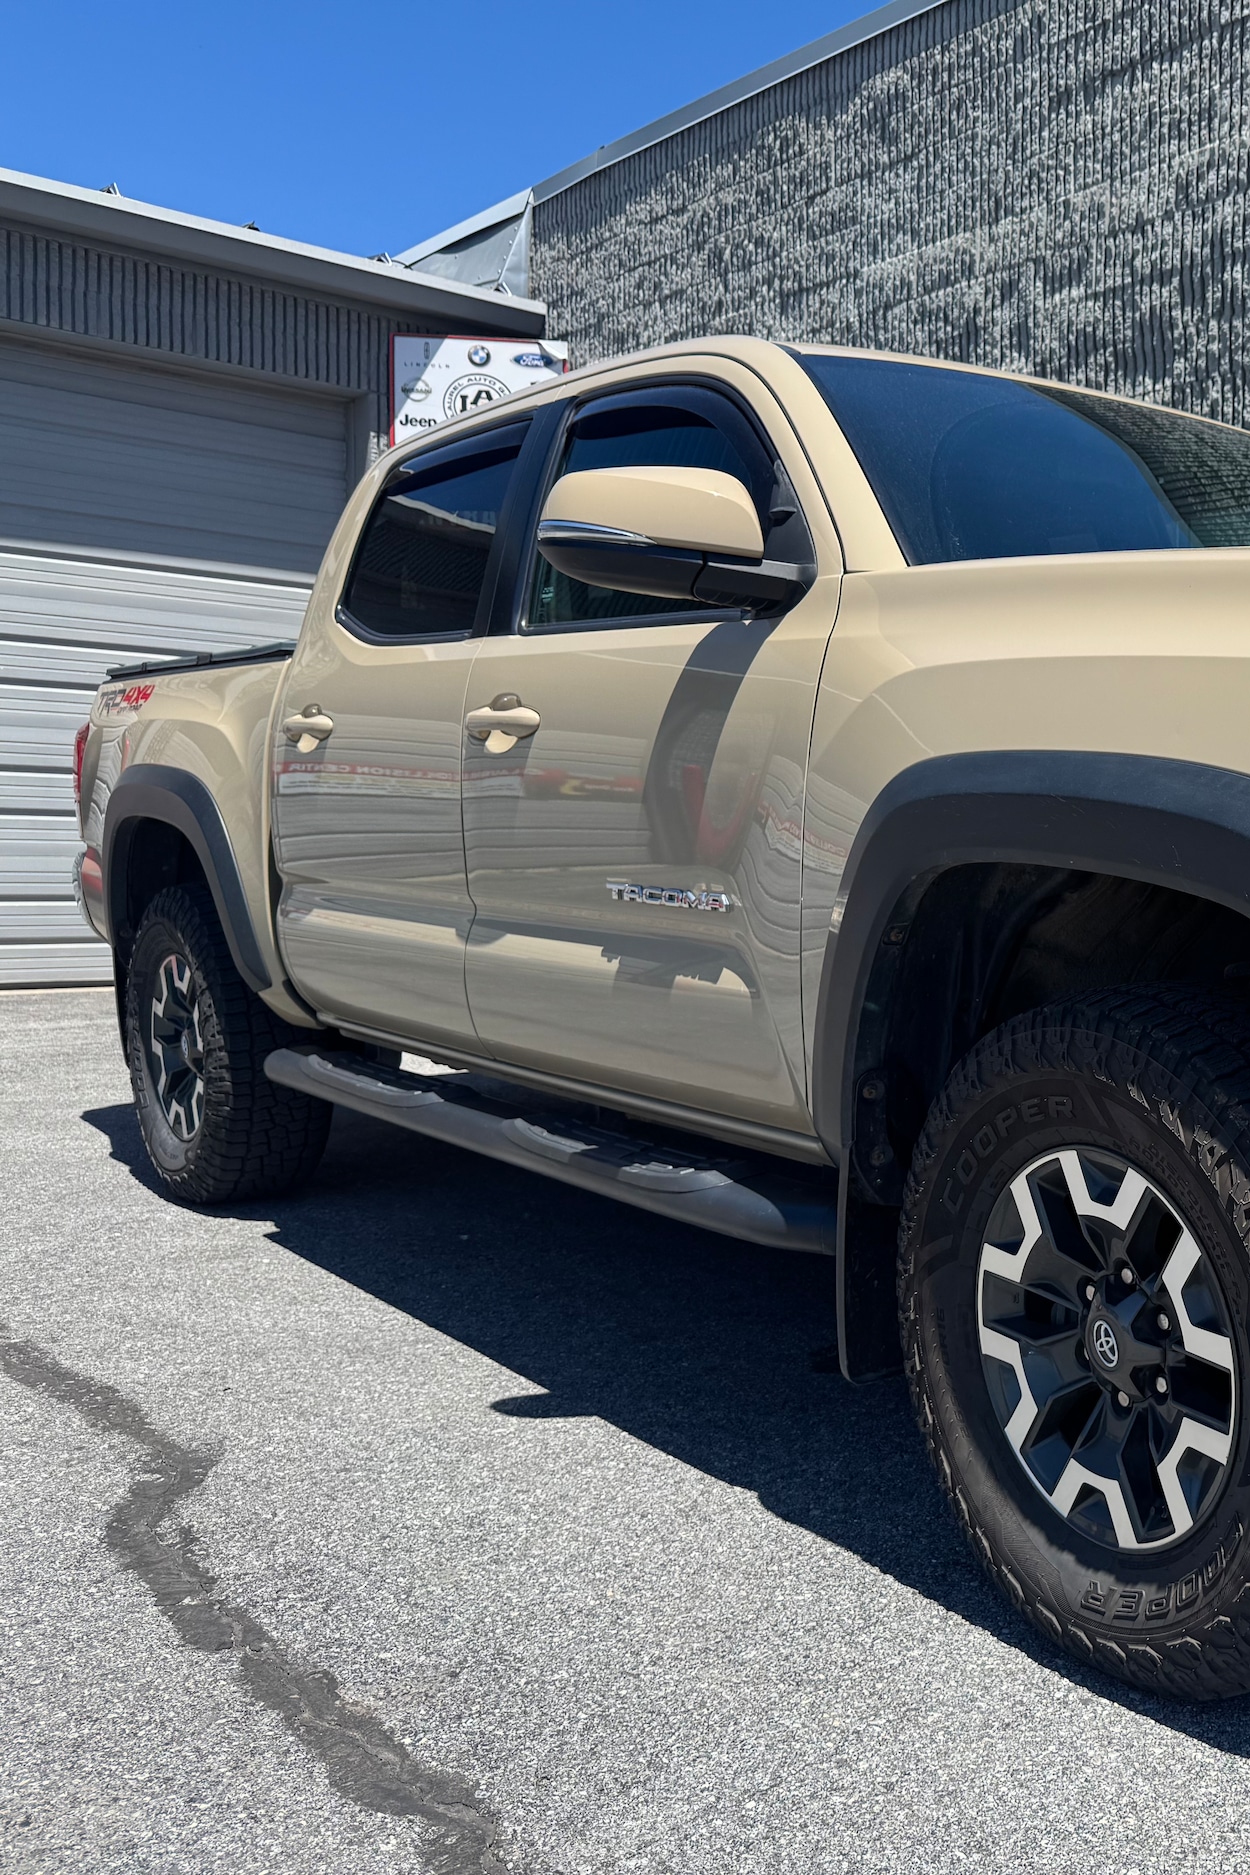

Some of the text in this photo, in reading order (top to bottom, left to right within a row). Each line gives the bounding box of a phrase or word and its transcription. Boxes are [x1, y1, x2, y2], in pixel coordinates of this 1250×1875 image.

[447, 382, 464, 417] LAUREL
[467, 376, 497, 386] AUTO
[399, 414, 437, 428] Jeep
[97, 689, 127, 717] TRD
[606, 883, 730, 912] TACOMA
[941, 1095, 1077, 1216] COOPER
[1081, 1511, 1244, 1622] COOPER
